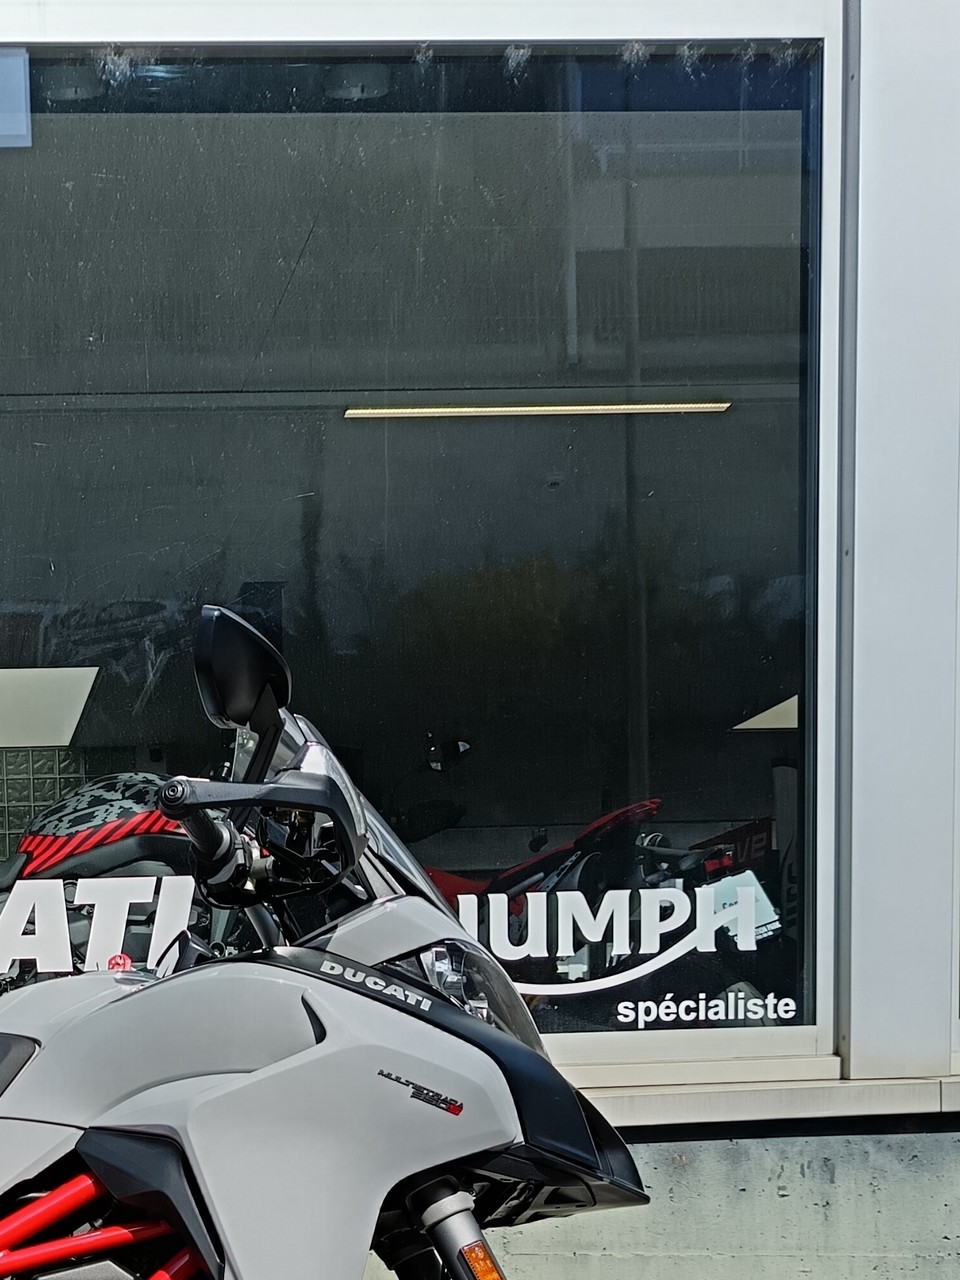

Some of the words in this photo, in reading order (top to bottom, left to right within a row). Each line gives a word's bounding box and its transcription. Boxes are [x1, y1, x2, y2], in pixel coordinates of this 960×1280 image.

[457, 886, 757, 961] IUMPH
[320, 960, 432, 1011] DUCATI
[616, 992, 797, 1029] spécialiste
